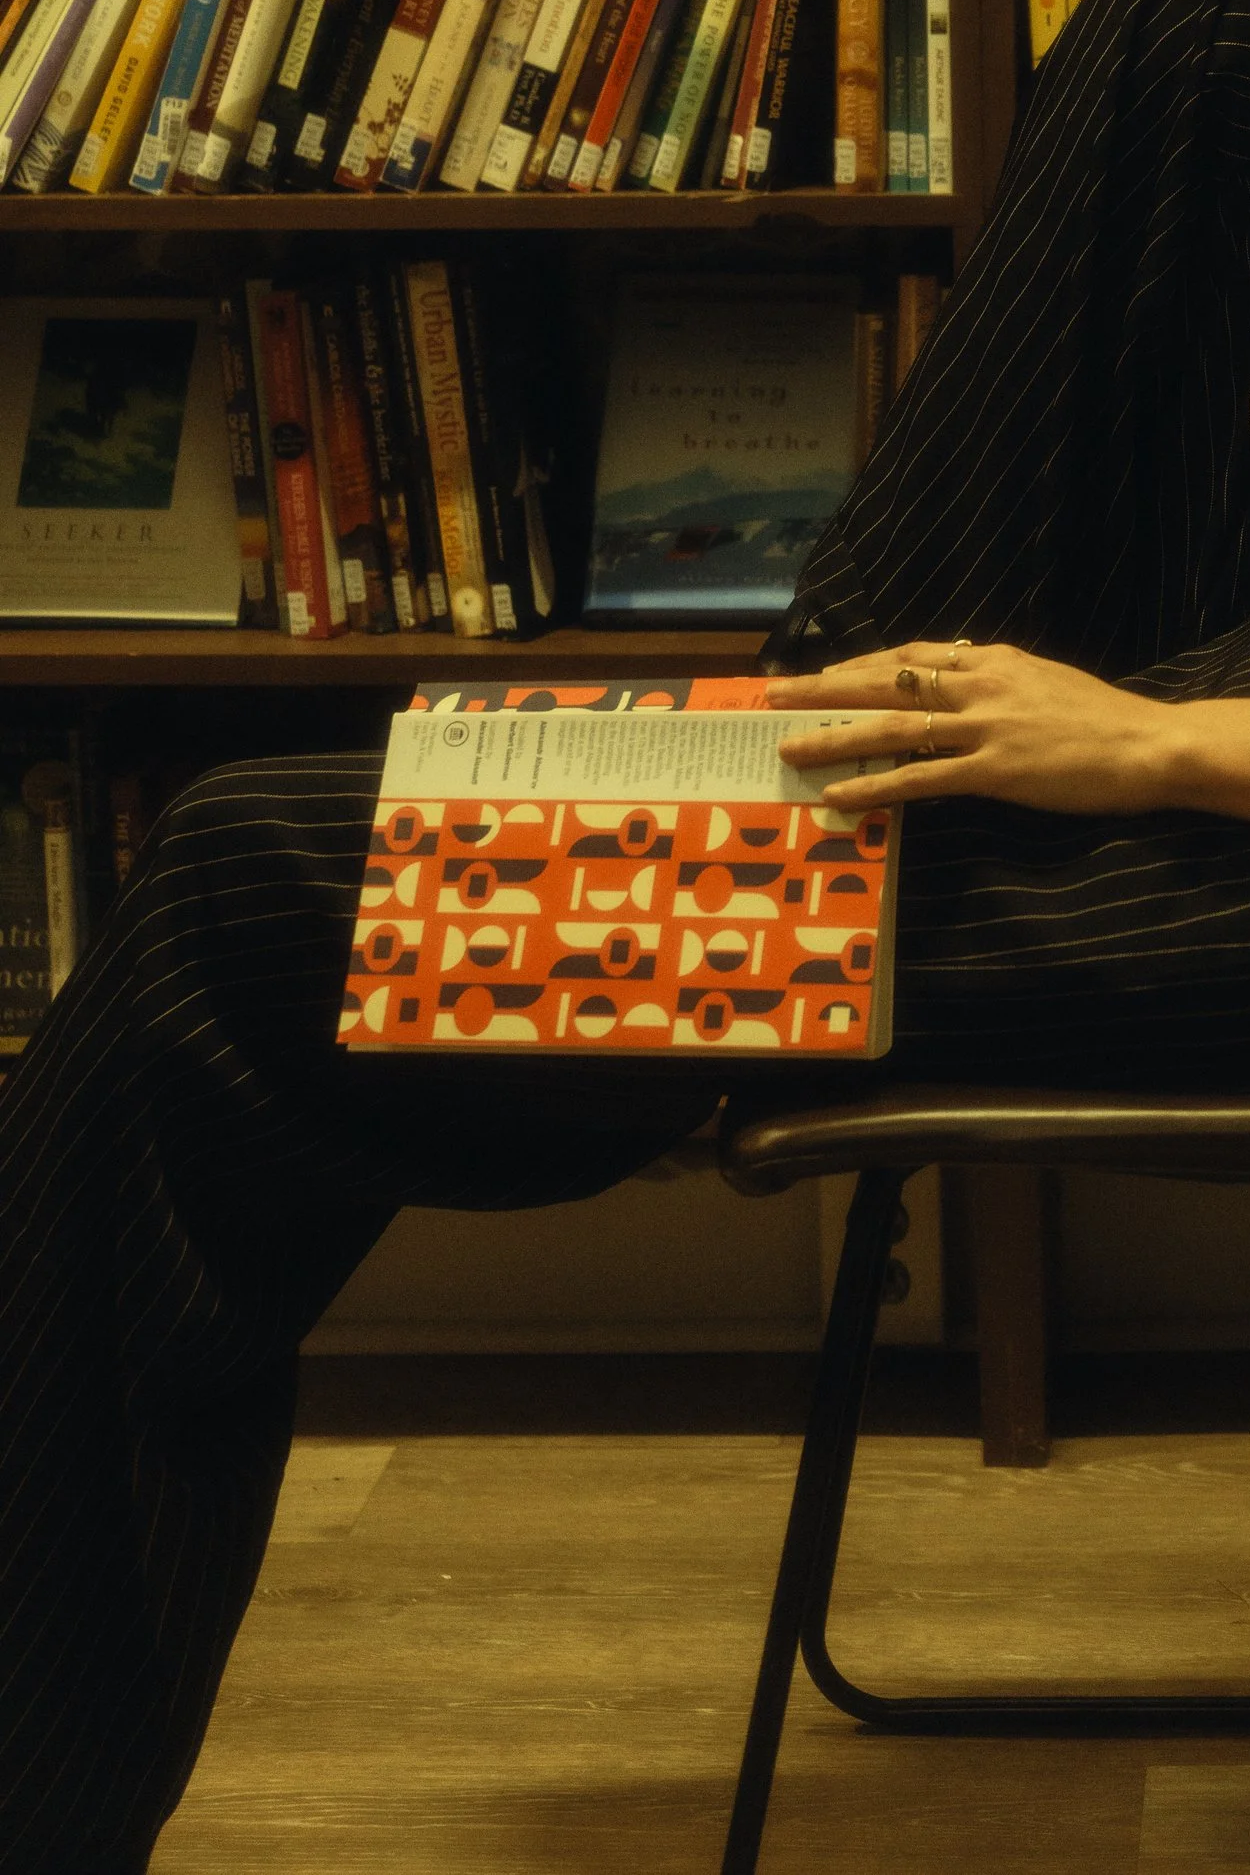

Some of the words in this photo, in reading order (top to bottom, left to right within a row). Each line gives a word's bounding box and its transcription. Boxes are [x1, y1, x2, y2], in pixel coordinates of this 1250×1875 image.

[767, 58, 789, 120] WARRIOR
[420, 288, 451, 366] Urban
[427, 372, 464, 452] Mystic
[629, 376, 787, 406] learning
[708, 409, 743, 425] to
[682, 432, 821, 452] breathe
[440, 513, 462, 580] Mellor
